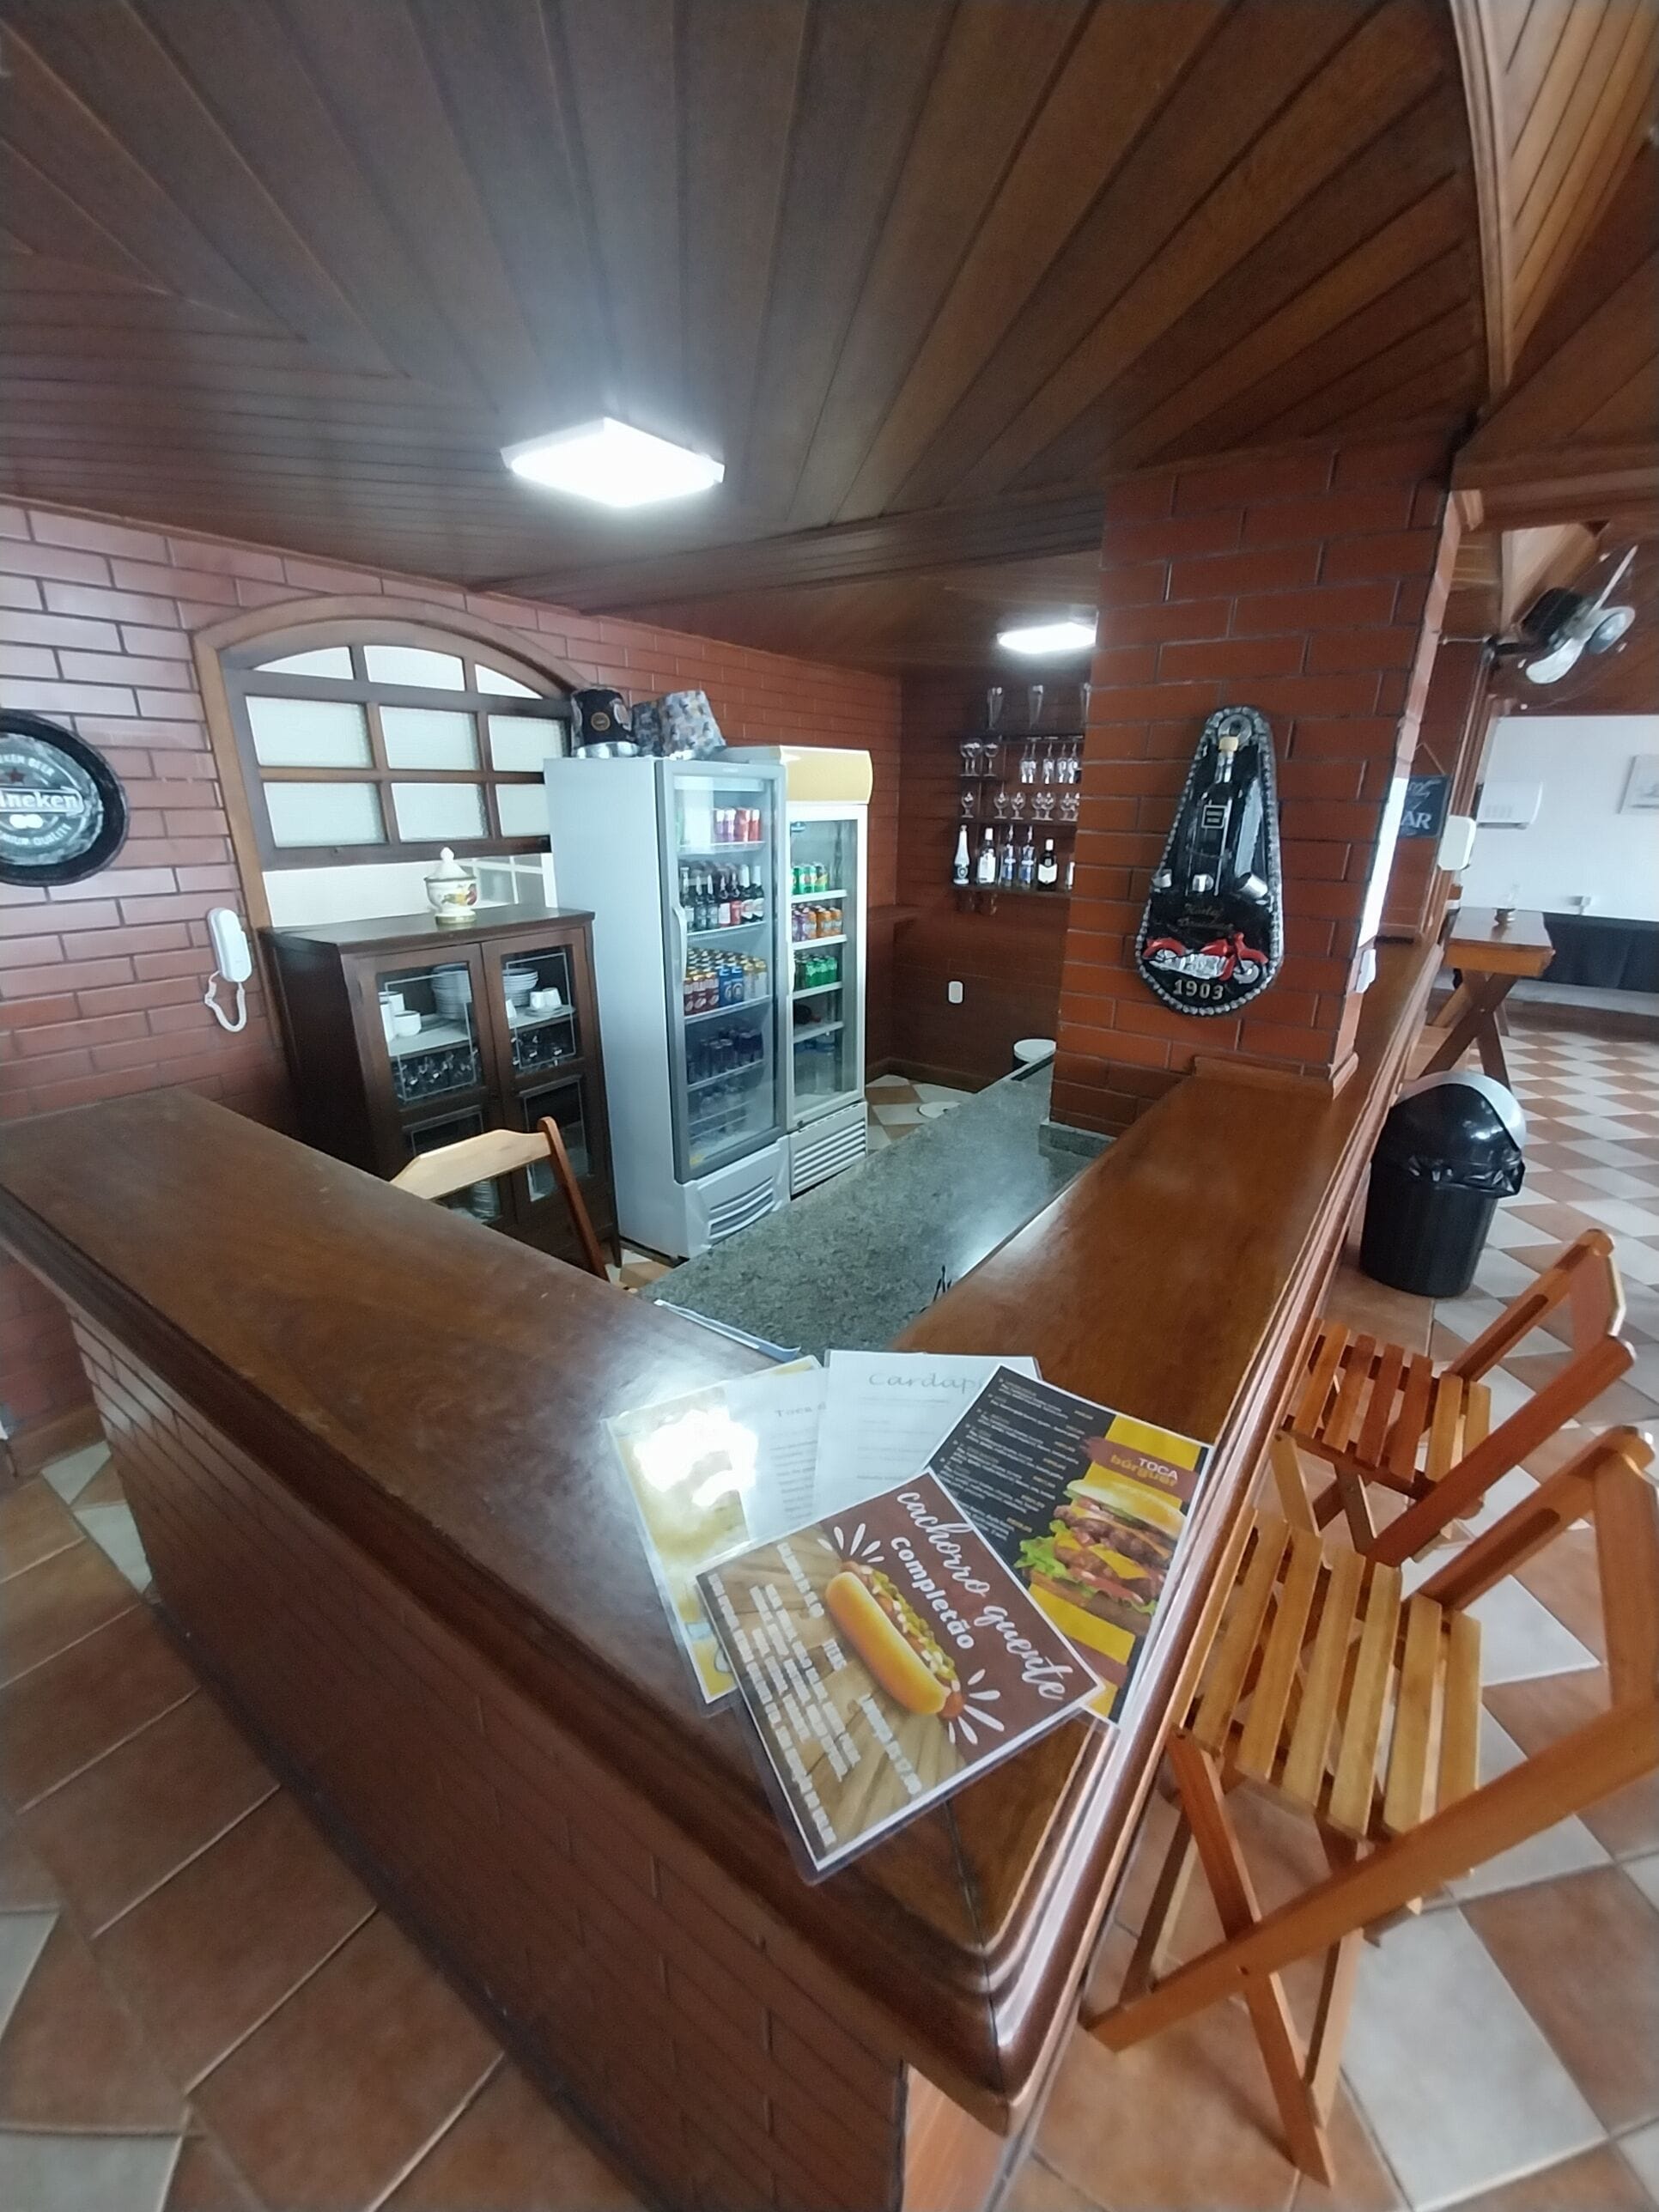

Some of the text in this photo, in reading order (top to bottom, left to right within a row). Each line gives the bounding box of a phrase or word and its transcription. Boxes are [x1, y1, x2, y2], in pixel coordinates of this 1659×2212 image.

[1173, 979, 1224, 1000] 1903
[1139, 1456, 1178, 1481] TOCA
[896, 1492, 990, 1597] cachorro
[974, 1605, 1073, 1700] quente
